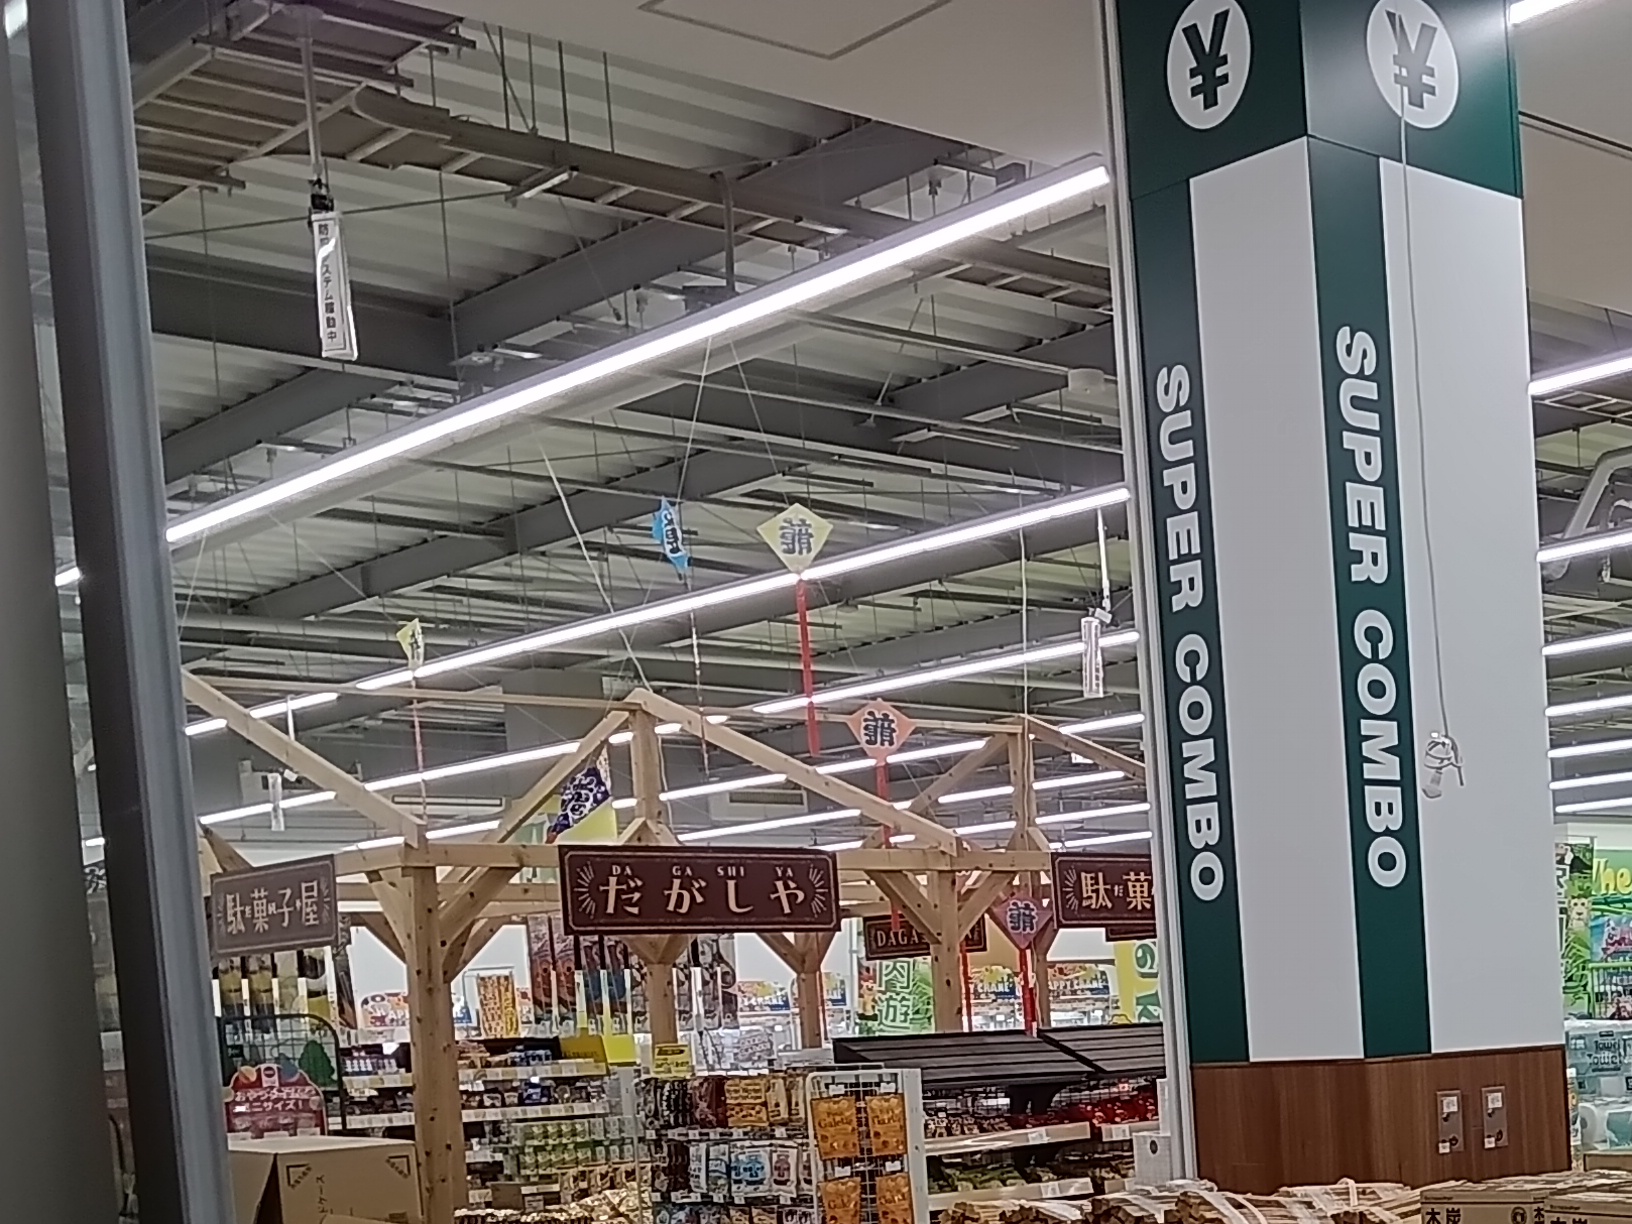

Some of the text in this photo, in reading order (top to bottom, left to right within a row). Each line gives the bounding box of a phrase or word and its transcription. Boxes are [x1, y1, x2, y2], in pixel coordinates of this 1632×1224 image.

[1156, 365, 1224, 901] SUPER COMBO
[1336, 326, 1407, 888] SUPER COMBO
[600, 876, 806, 915] だがしや
